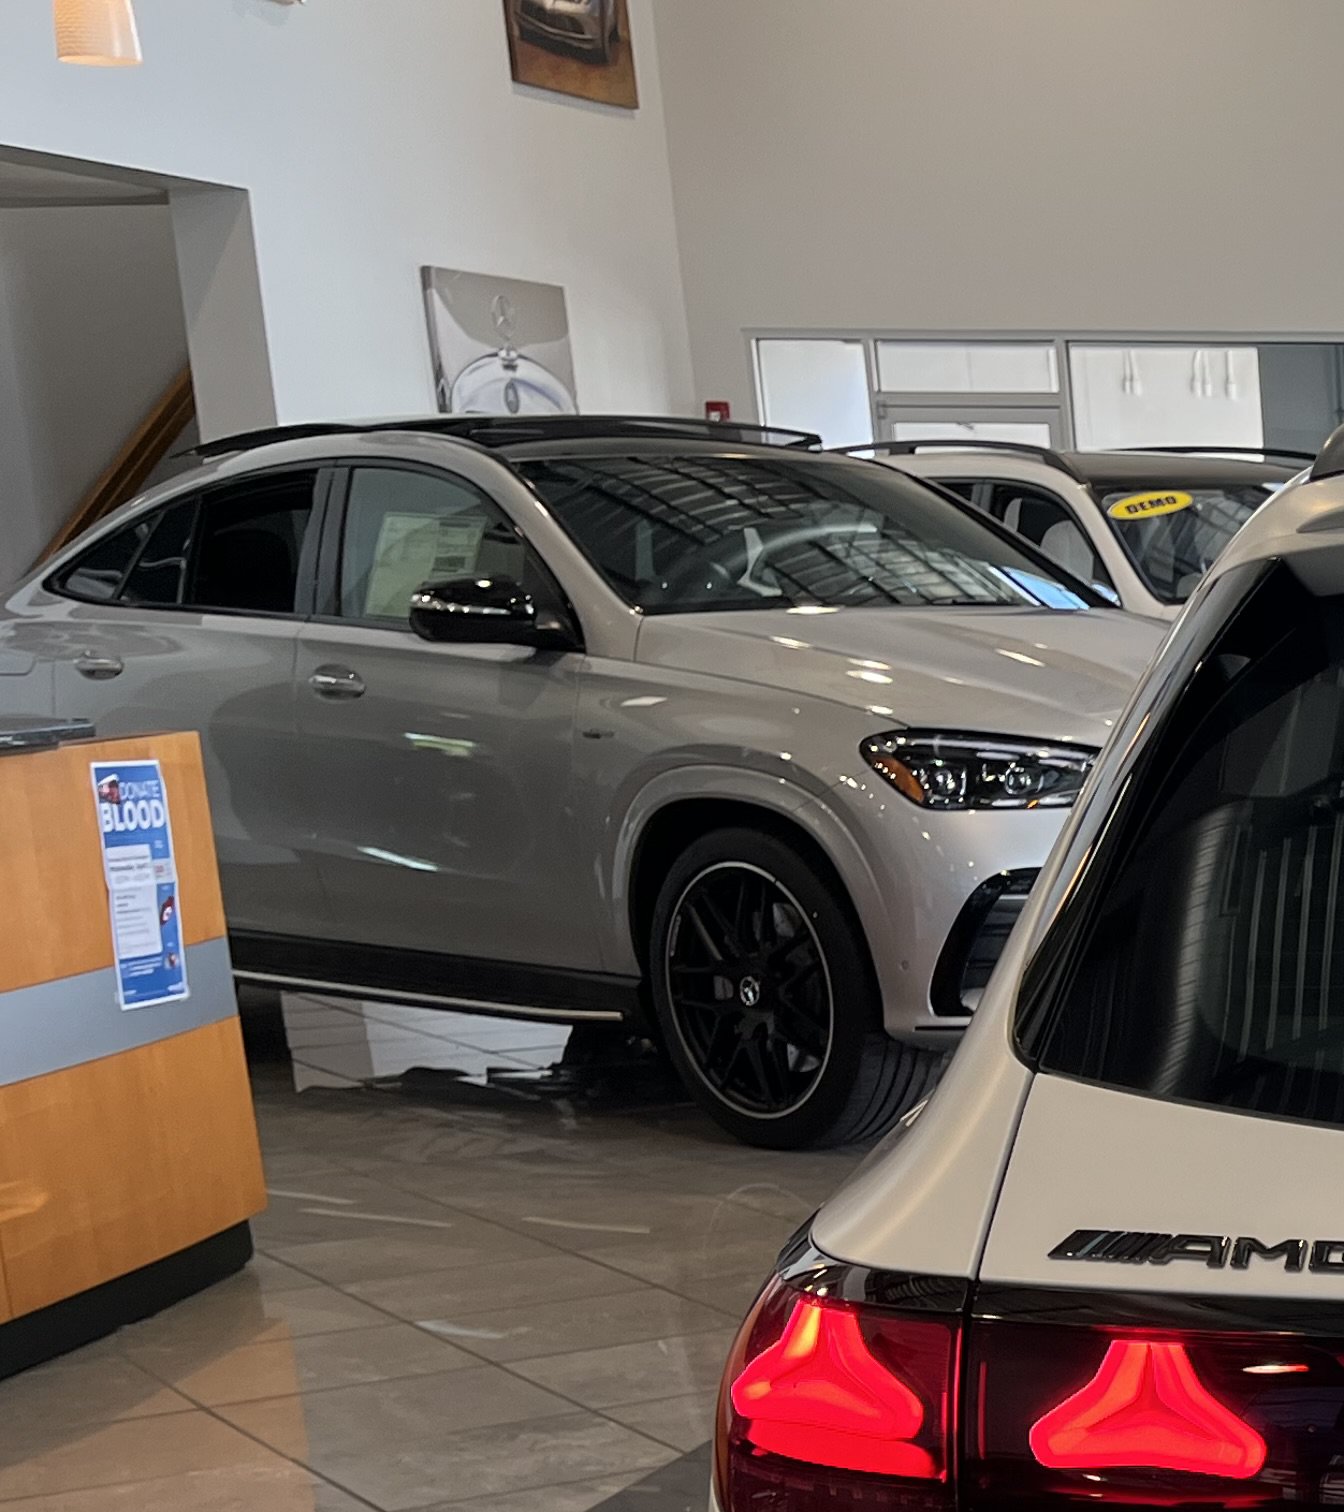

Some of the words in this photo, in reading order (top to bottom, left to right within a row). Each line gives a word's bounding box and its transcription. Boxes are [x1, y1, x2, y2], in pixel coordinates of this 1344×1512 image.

[1126, 496, 1176, 514] DEMO
[119, 780, 160, 800] DONATE
[101, 800, 164, 832] BLOOD
